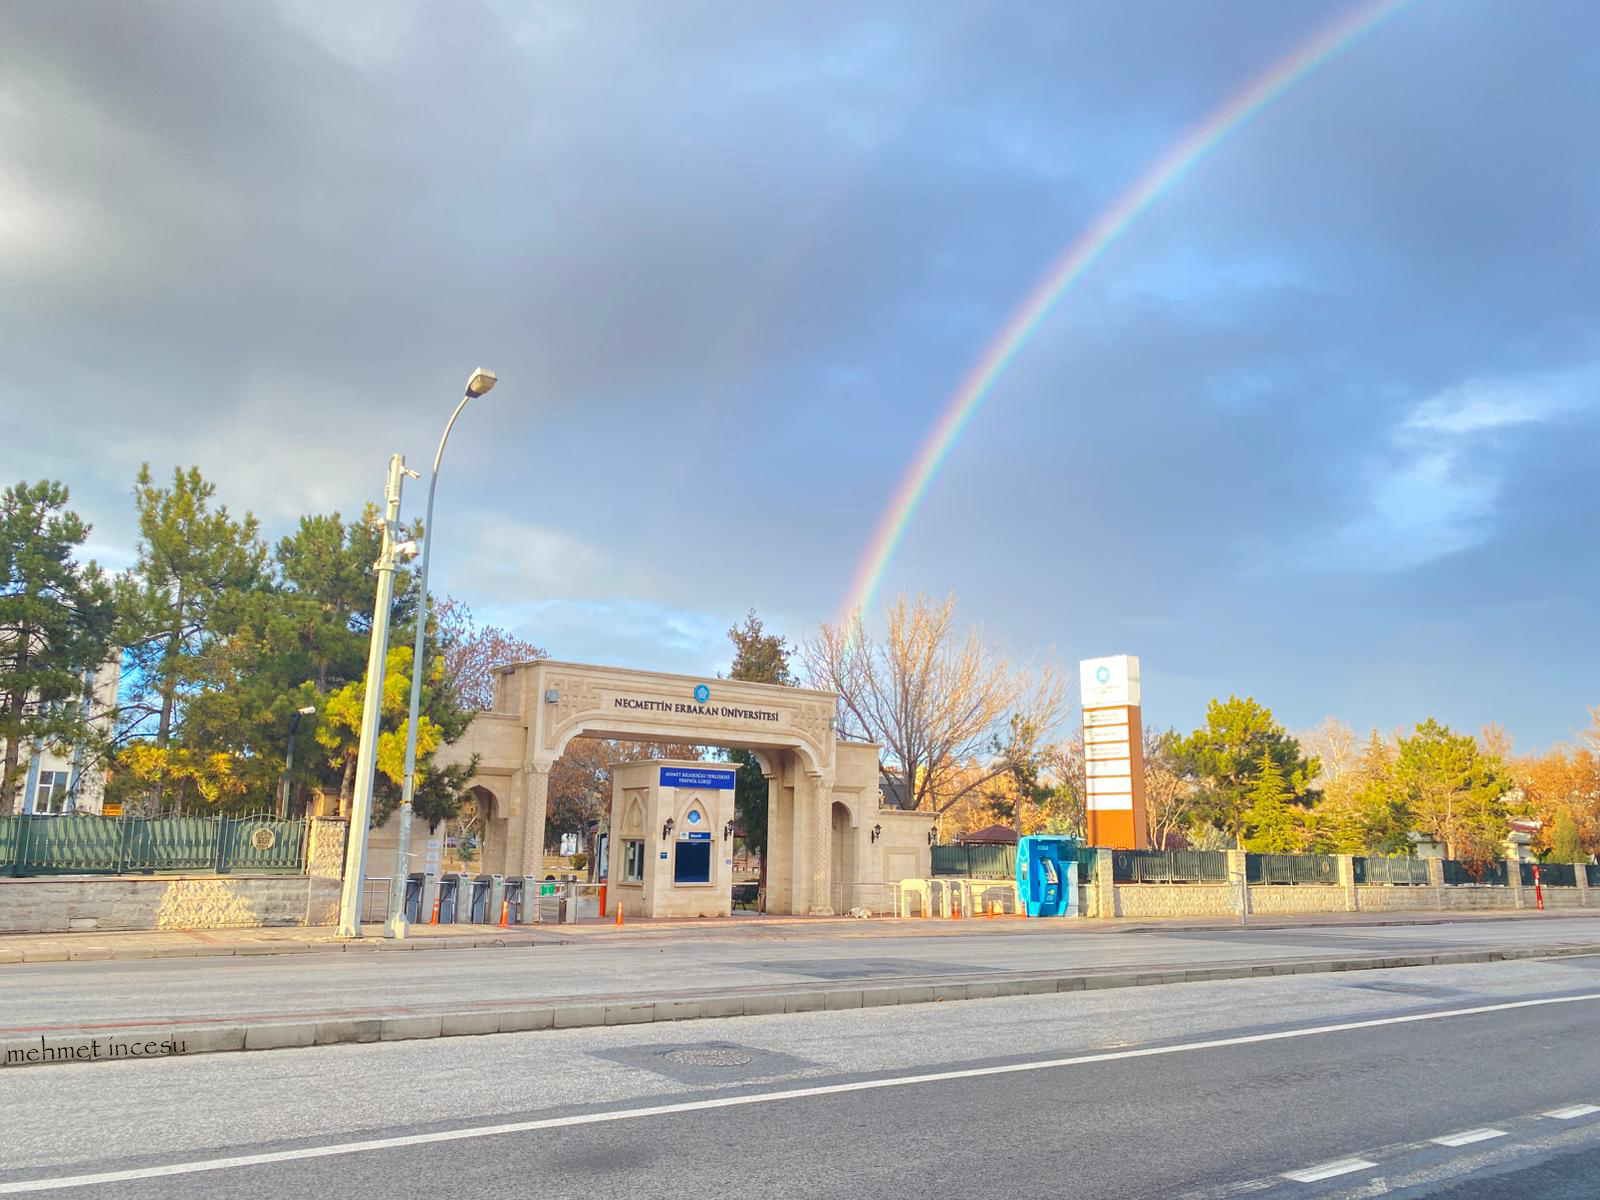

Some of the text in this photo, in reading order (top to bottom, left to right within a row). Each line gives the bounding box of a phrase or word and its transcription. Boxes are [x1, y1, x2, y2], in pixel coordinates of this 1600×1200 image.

[614, 697, 779, 722] NECMETTİN ERBAKAN ÜNİVERSİTESİ
